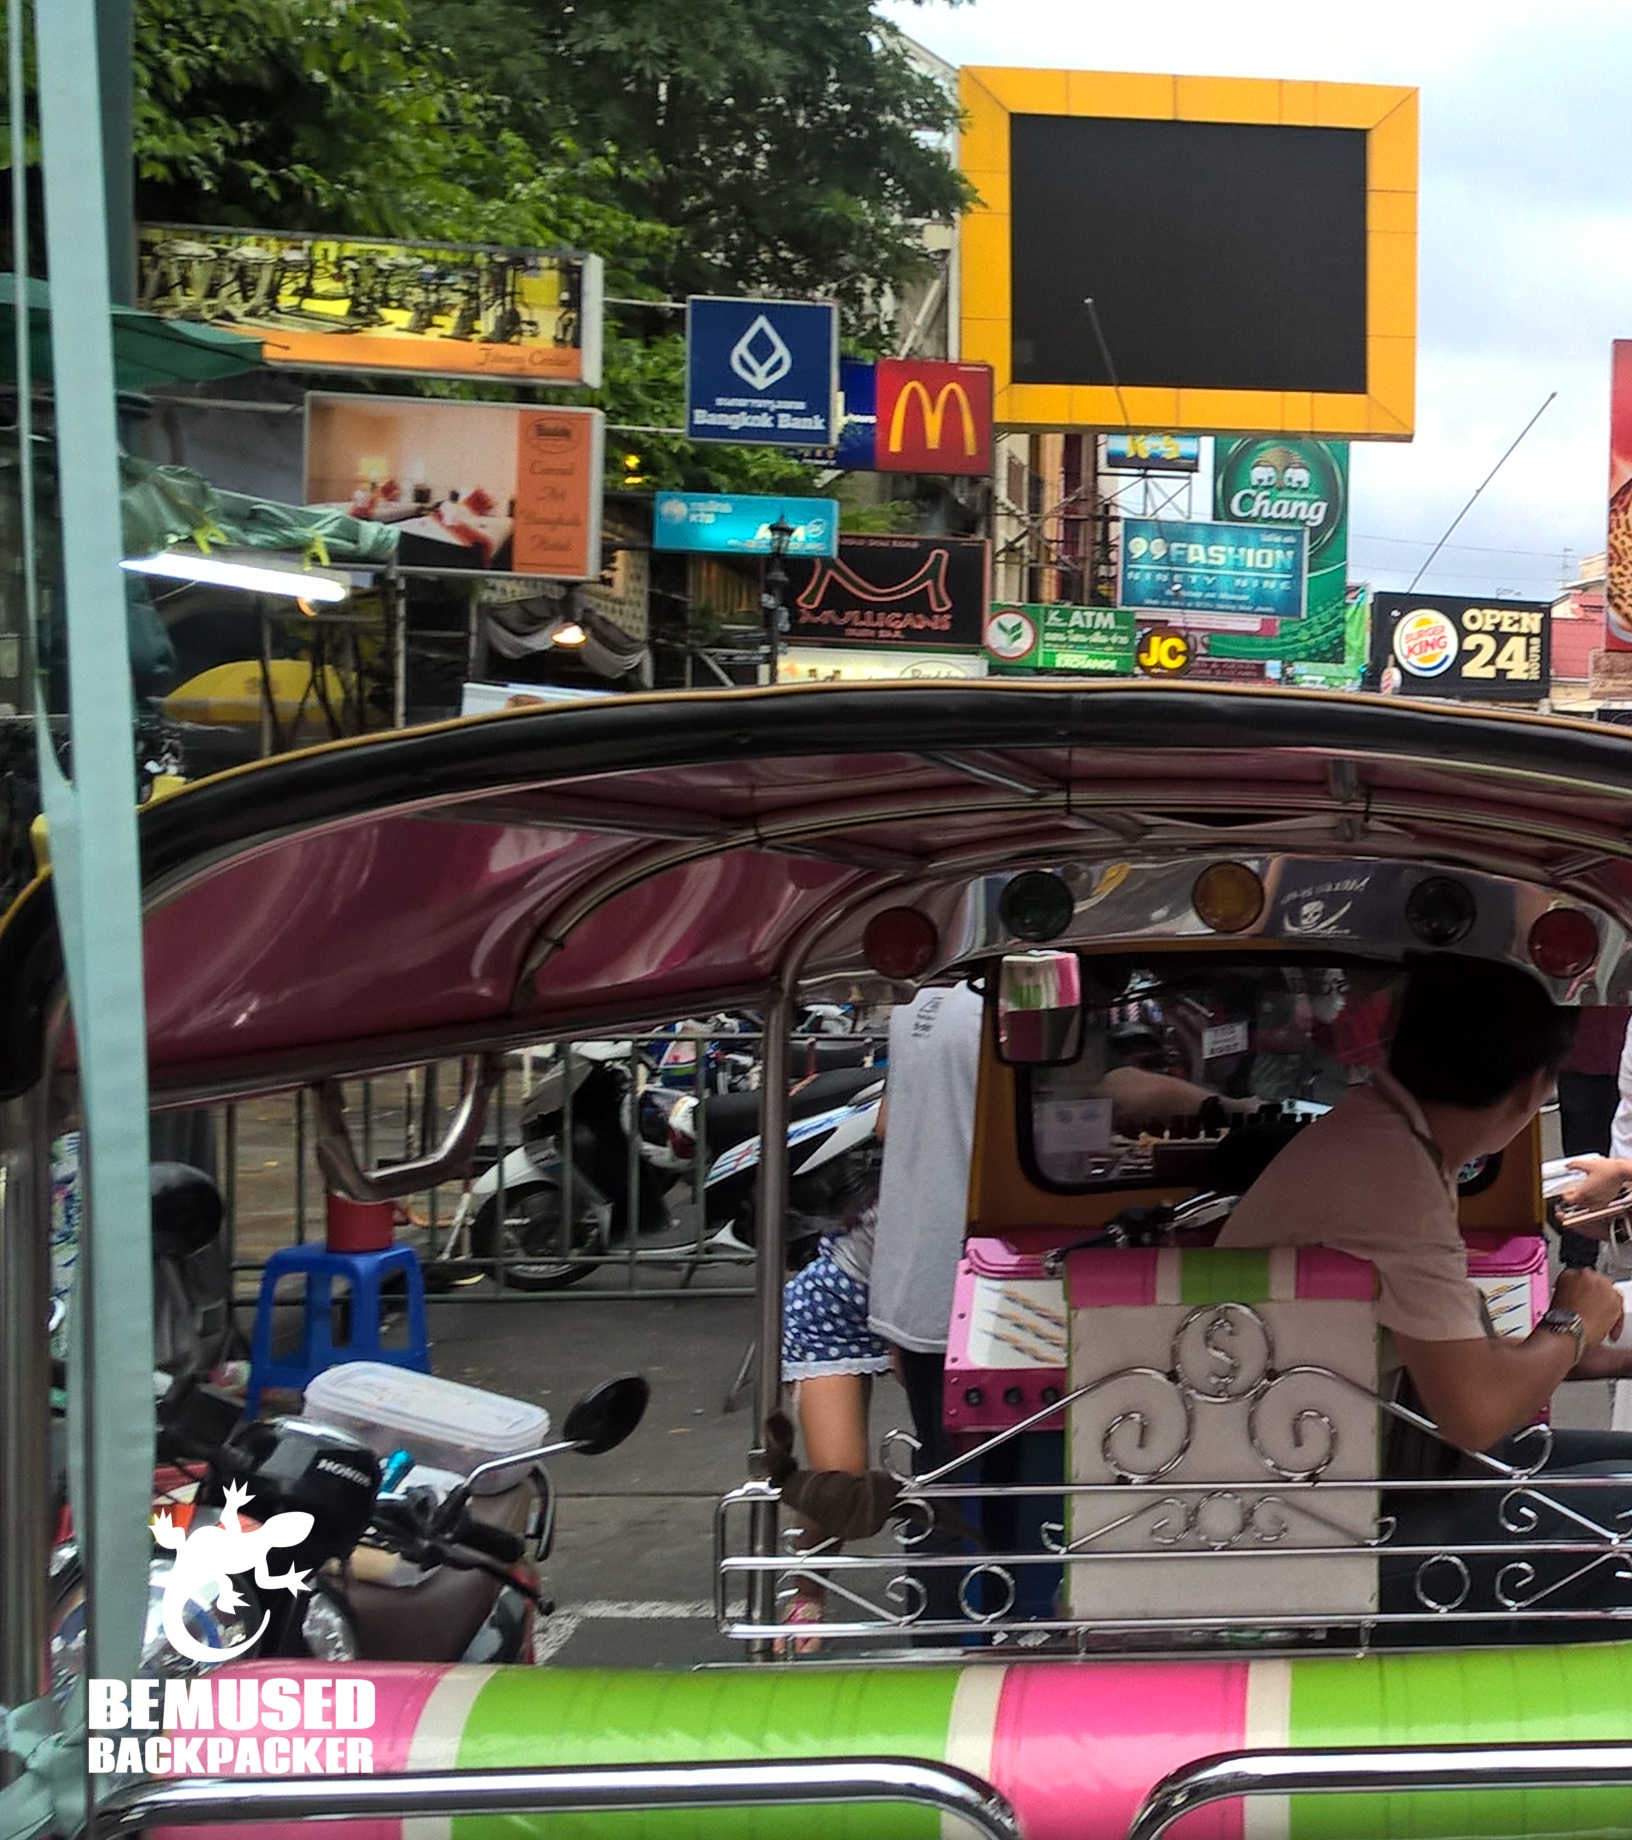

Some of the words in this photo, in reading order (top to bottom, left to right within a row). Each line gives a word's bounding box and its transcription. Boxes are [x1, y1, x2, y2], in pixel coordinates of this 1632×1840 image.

[692, 409, 775, 431] Bangkok
[777, 413, 827, 430] Bank
[1229, 488, 1329, 528] Chang
[1127, 536, 1168, 560] 99
[1169, 542, 1294, 569] FASHION
[1068, 611, 1116, 629] ATM
[1462, 608, 1543, 634] OPEN
[1404, 625, 1446, 643] BURGER
[1139, 636, 1187, 669] JC
[1405, 636, 1448, 660] KING
[1461, 633, 1530, 680] 24
